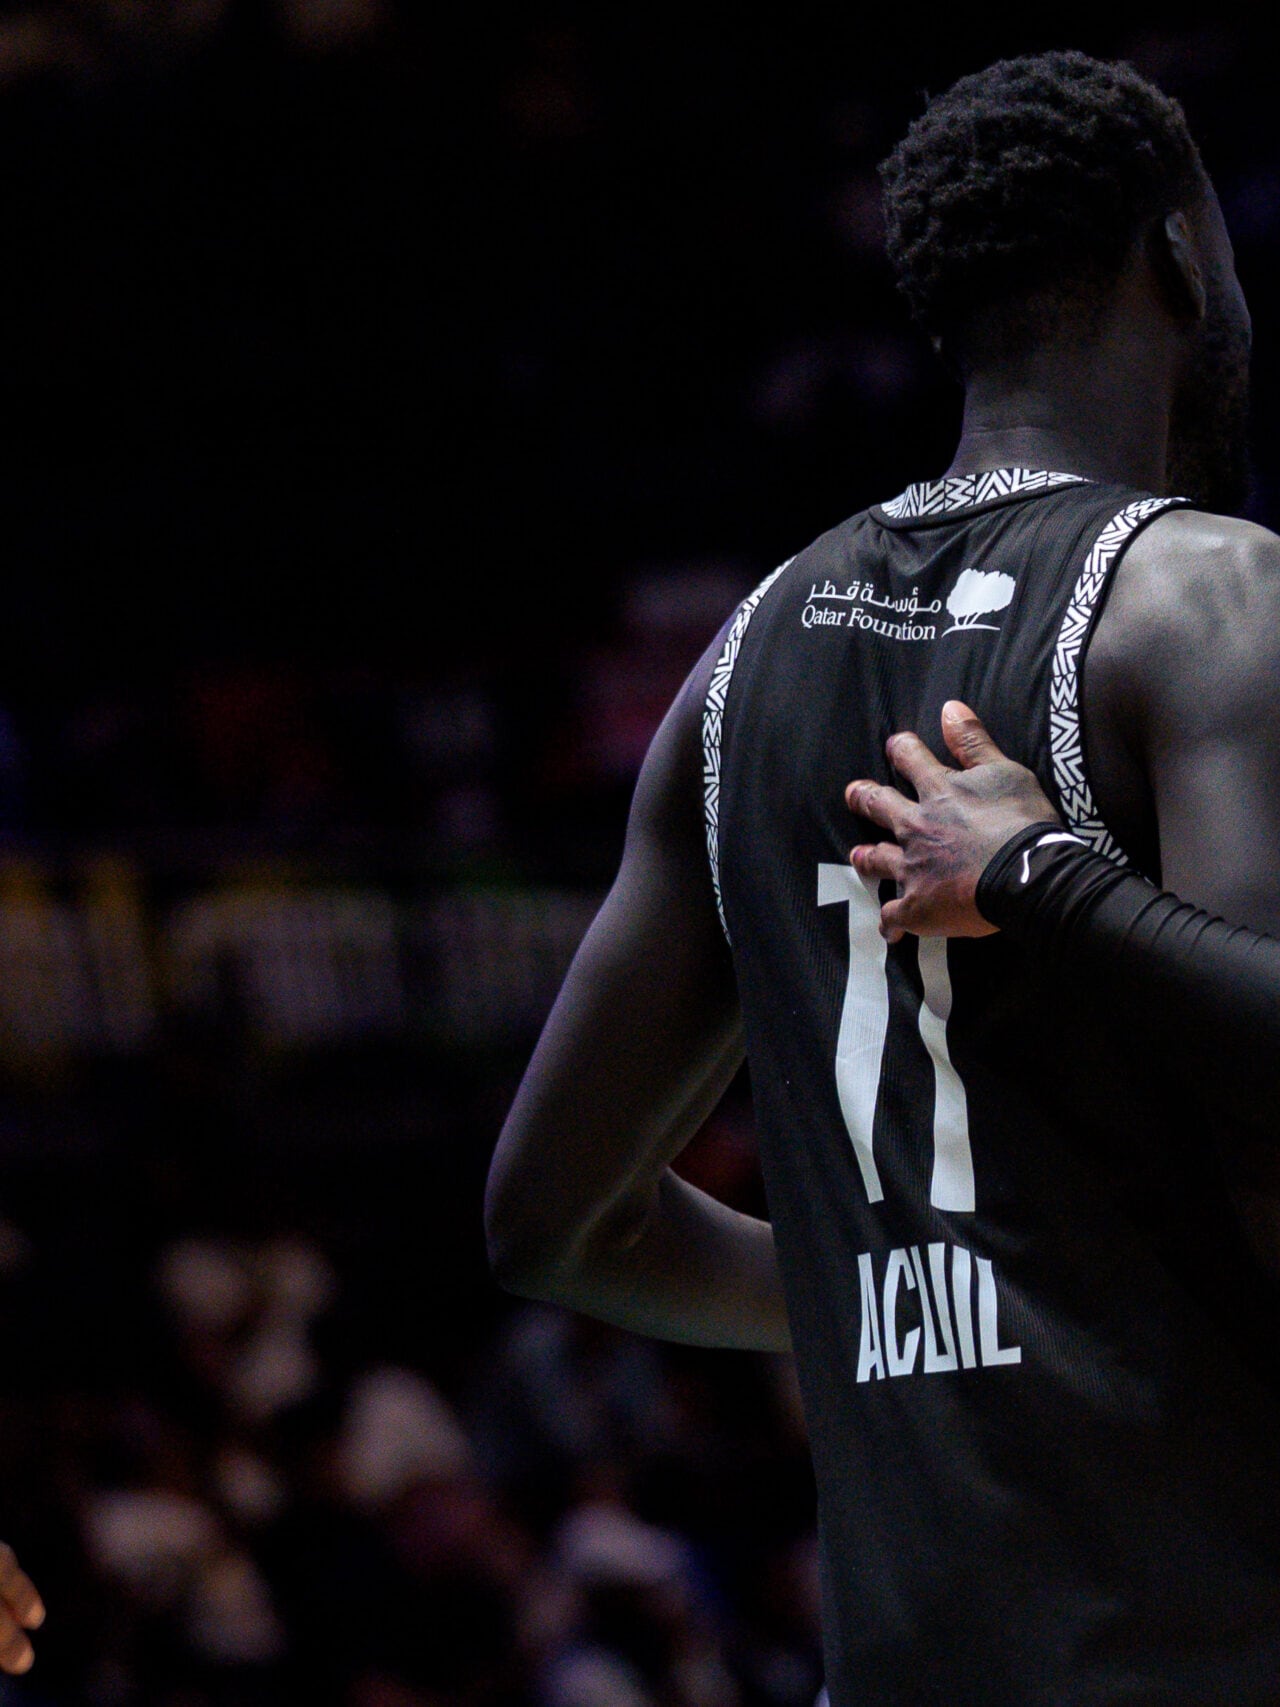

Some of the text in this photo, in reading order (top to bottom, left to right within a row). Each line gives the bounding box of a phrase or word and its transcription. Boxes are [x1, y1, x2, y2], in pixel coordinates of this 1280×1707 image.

[801, 604, 936, 640] Qatar Fountion
[856, 1242, 1022, 1383] ACUIL
